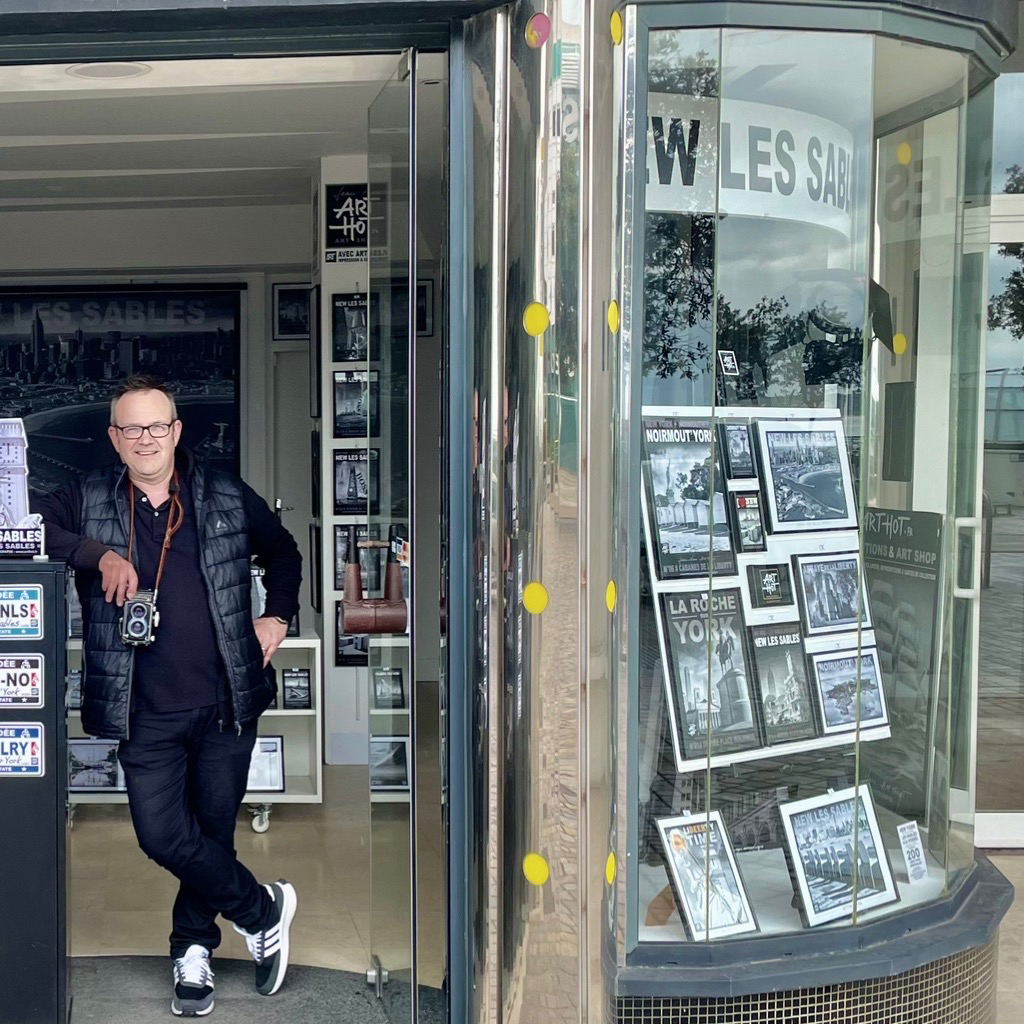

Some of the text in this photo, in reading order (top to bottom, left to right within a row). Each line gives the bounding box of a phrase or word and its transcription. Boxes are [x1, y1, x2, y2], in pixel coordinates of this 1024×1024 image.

[721, 122, 796, 196] LES
[13, 301, 72, 327] LES
[81, 300, 206, 327] SABLES
[888, 545, 895, 558] &
[896, 547, 912, 560] ART
[914, 549, 937, 565] SHOP
[669, 595, 736, 614] LA ROCHE
[673, 617, 737, 644] YORK
[768, 635, 778, 645] LES
[779, 633, 800, 645] SABLES
[3, 755, 23, 764] York
[793, 813, 813, 829] NEW
[814, 808, 830, 822] LES
